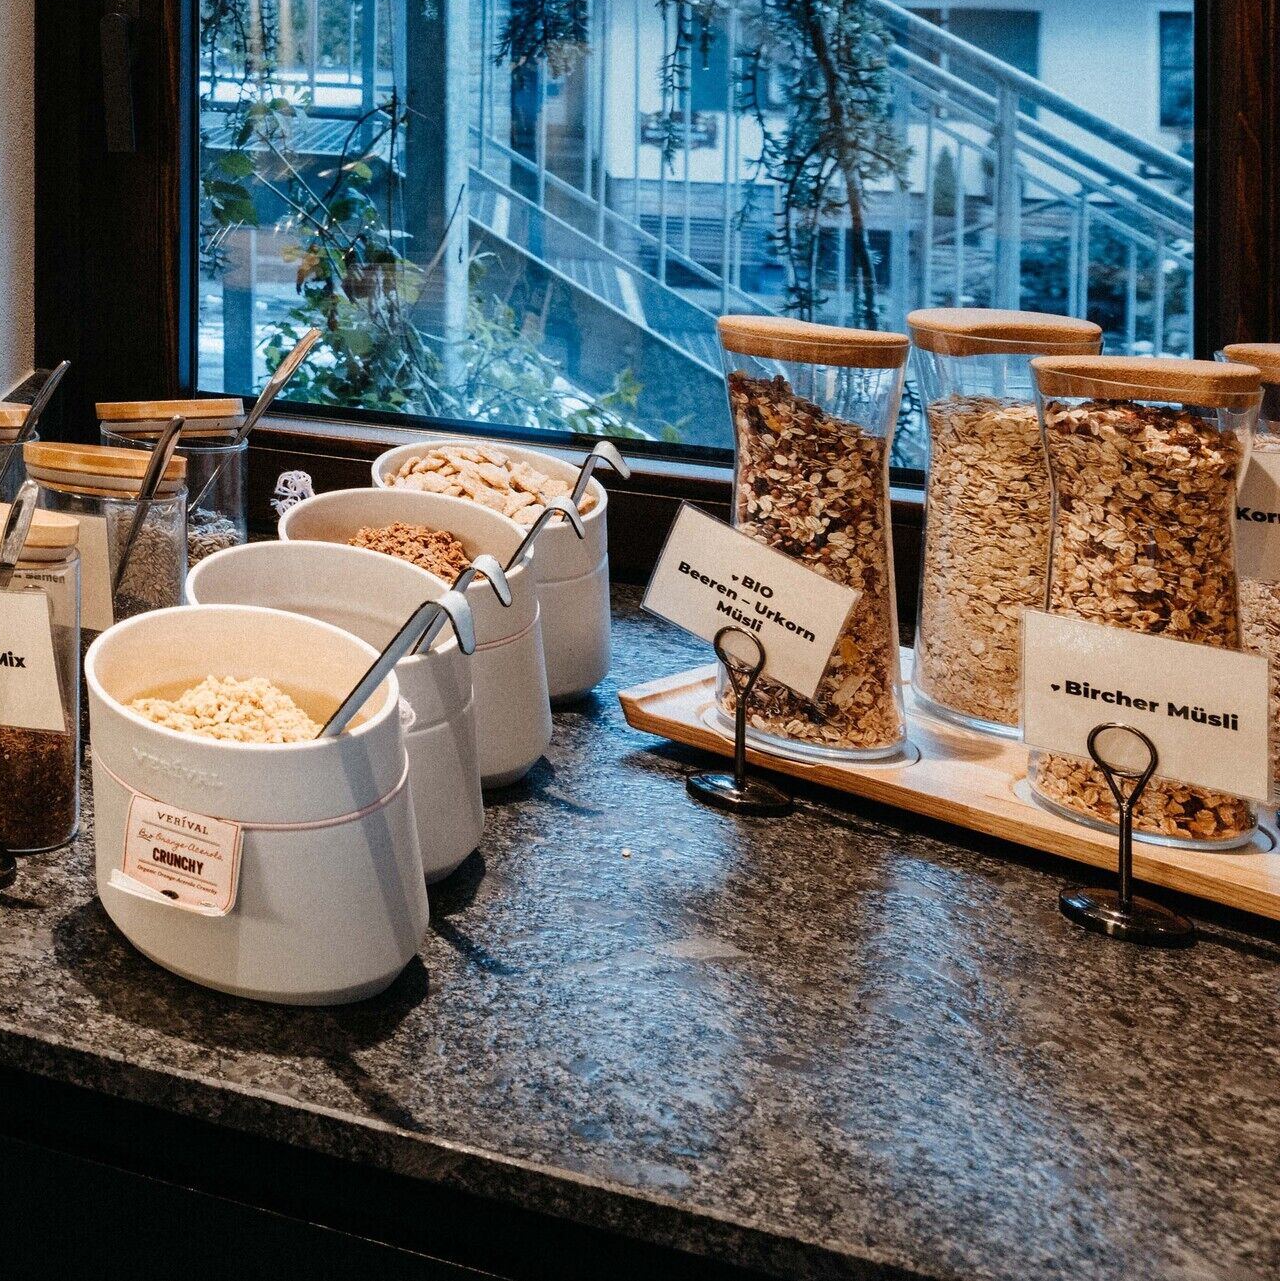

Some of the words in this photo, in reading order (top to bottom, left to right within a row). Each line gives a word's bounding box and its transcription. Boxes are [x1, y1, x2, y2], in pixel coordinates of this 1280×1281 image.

[1236, 506, 1280, 524] Kor
[678, 560, 738, 601] Beeren
[754, 601, 817, 642] Urkorn
[741, 575, 774, 599] BIO
[716, 599, 764, 633] Müsli
[1064, 679, 1160, 713] Bircher
[1167, 701, 1239, 731] Müsli
[157, 811, 209, 835] VERÍVAL
[152, 847, 204, 876] CRUNCHY
